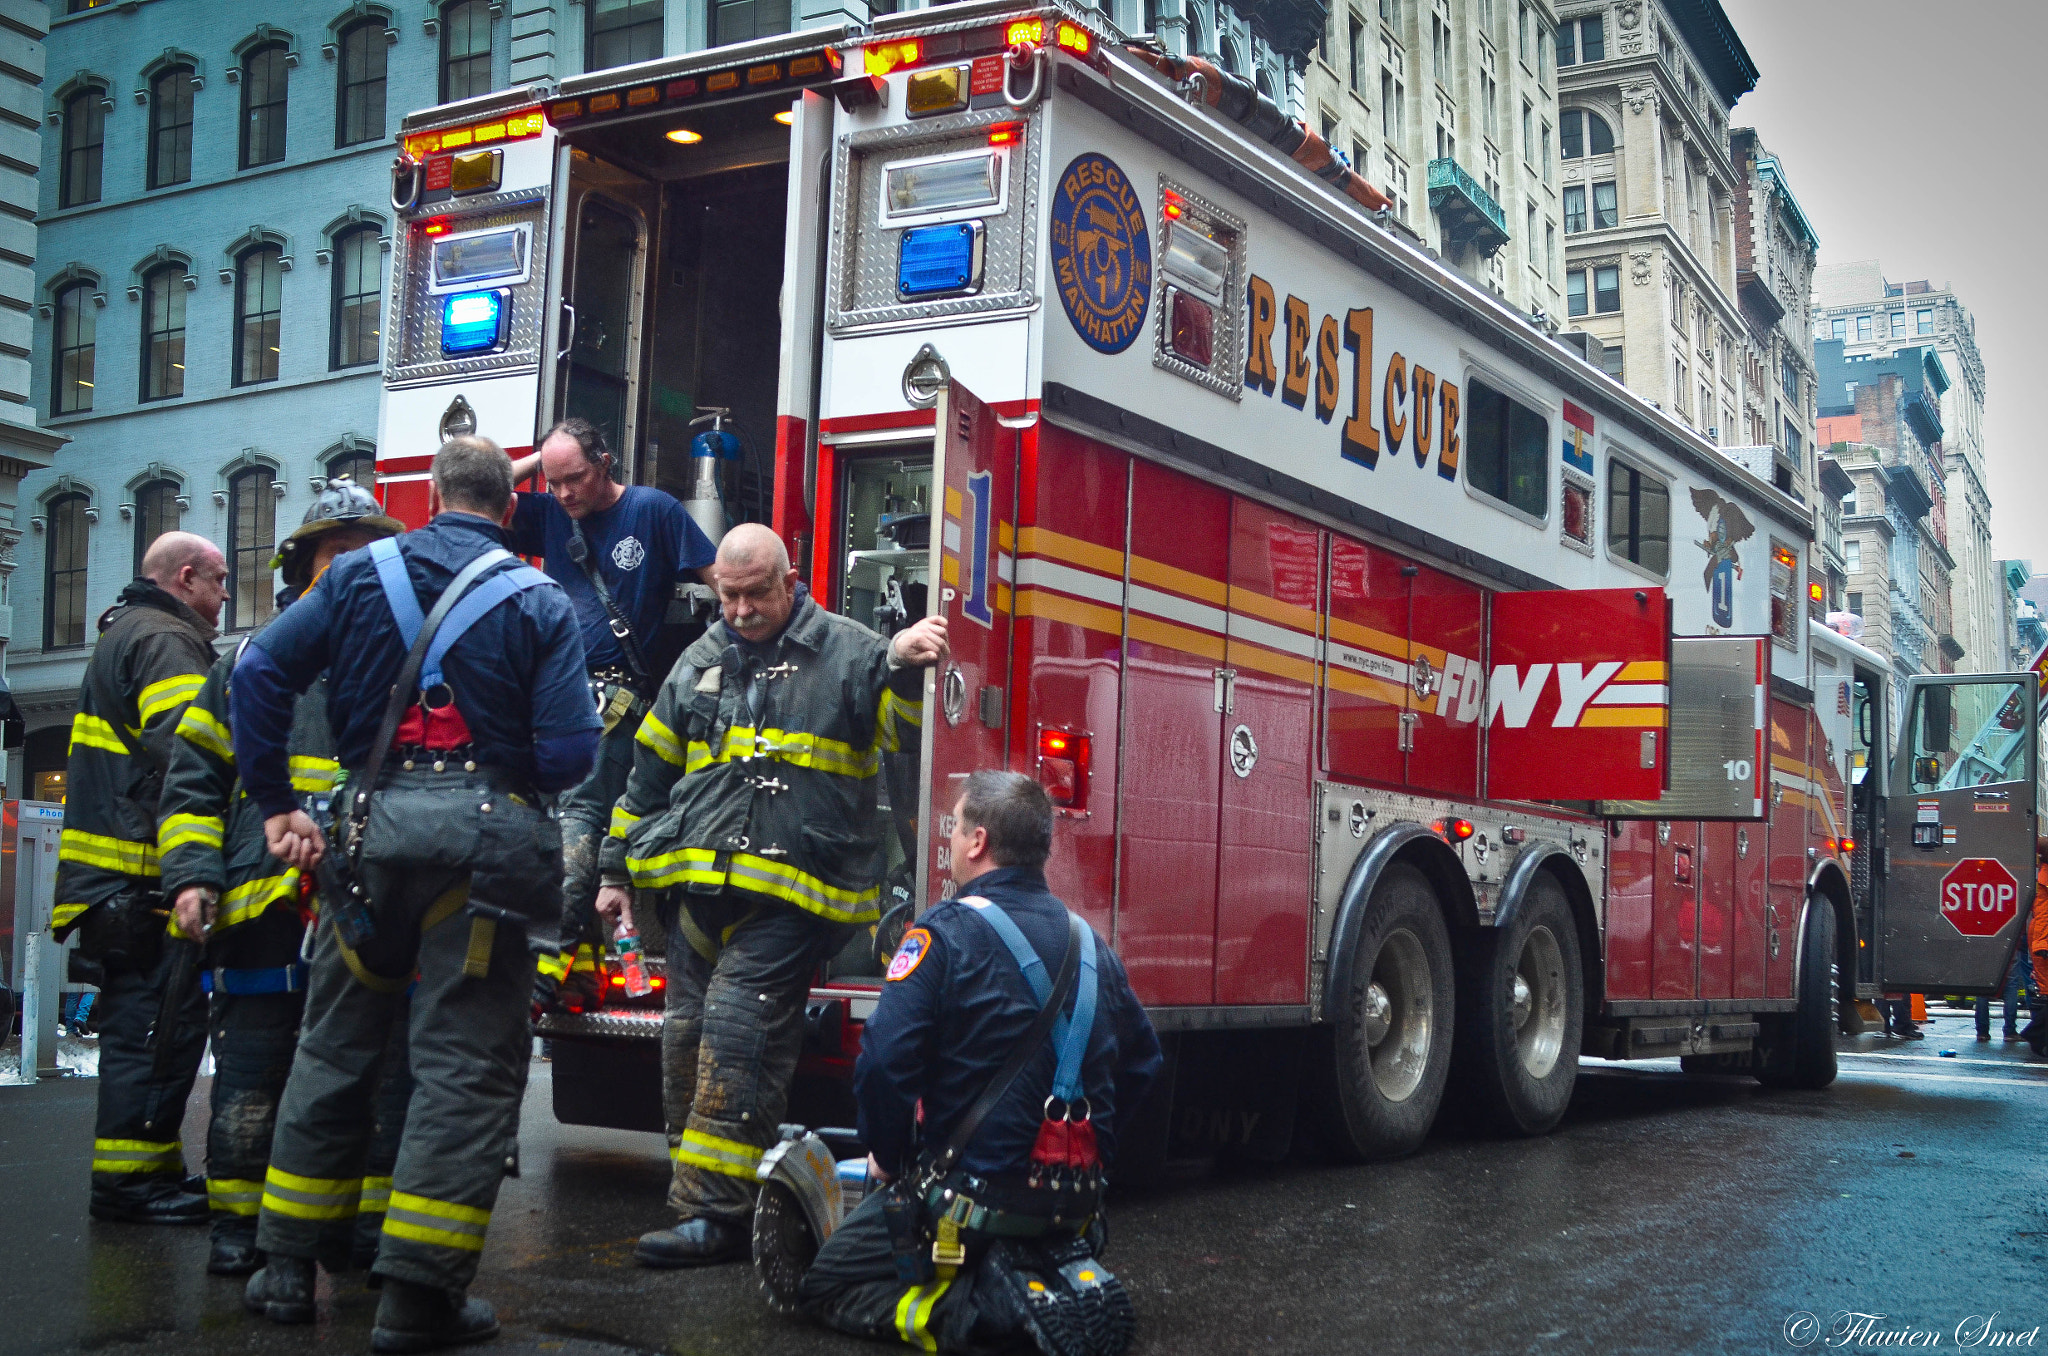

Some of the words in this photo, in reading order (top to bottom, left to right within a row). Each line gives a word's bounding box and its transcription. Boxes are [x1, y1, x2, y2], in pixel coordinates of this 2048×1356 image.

[1064, 161, 1145, 237] RESCUE
[1058, 255, 1146, 344] MANHATTAN
[1094, 273, 1107, 304] 1
[962, 469, 993, 630] 1
[1718, 571, 1728, 612] 1
[1436, 652, 1623, 729] FDNY
[1722, 760, 1751, 780] 10
[39, 808, 63, 818] Phon
[937, 845, 951, 870] BA
[1944, 882, 2014, 912] STOP
